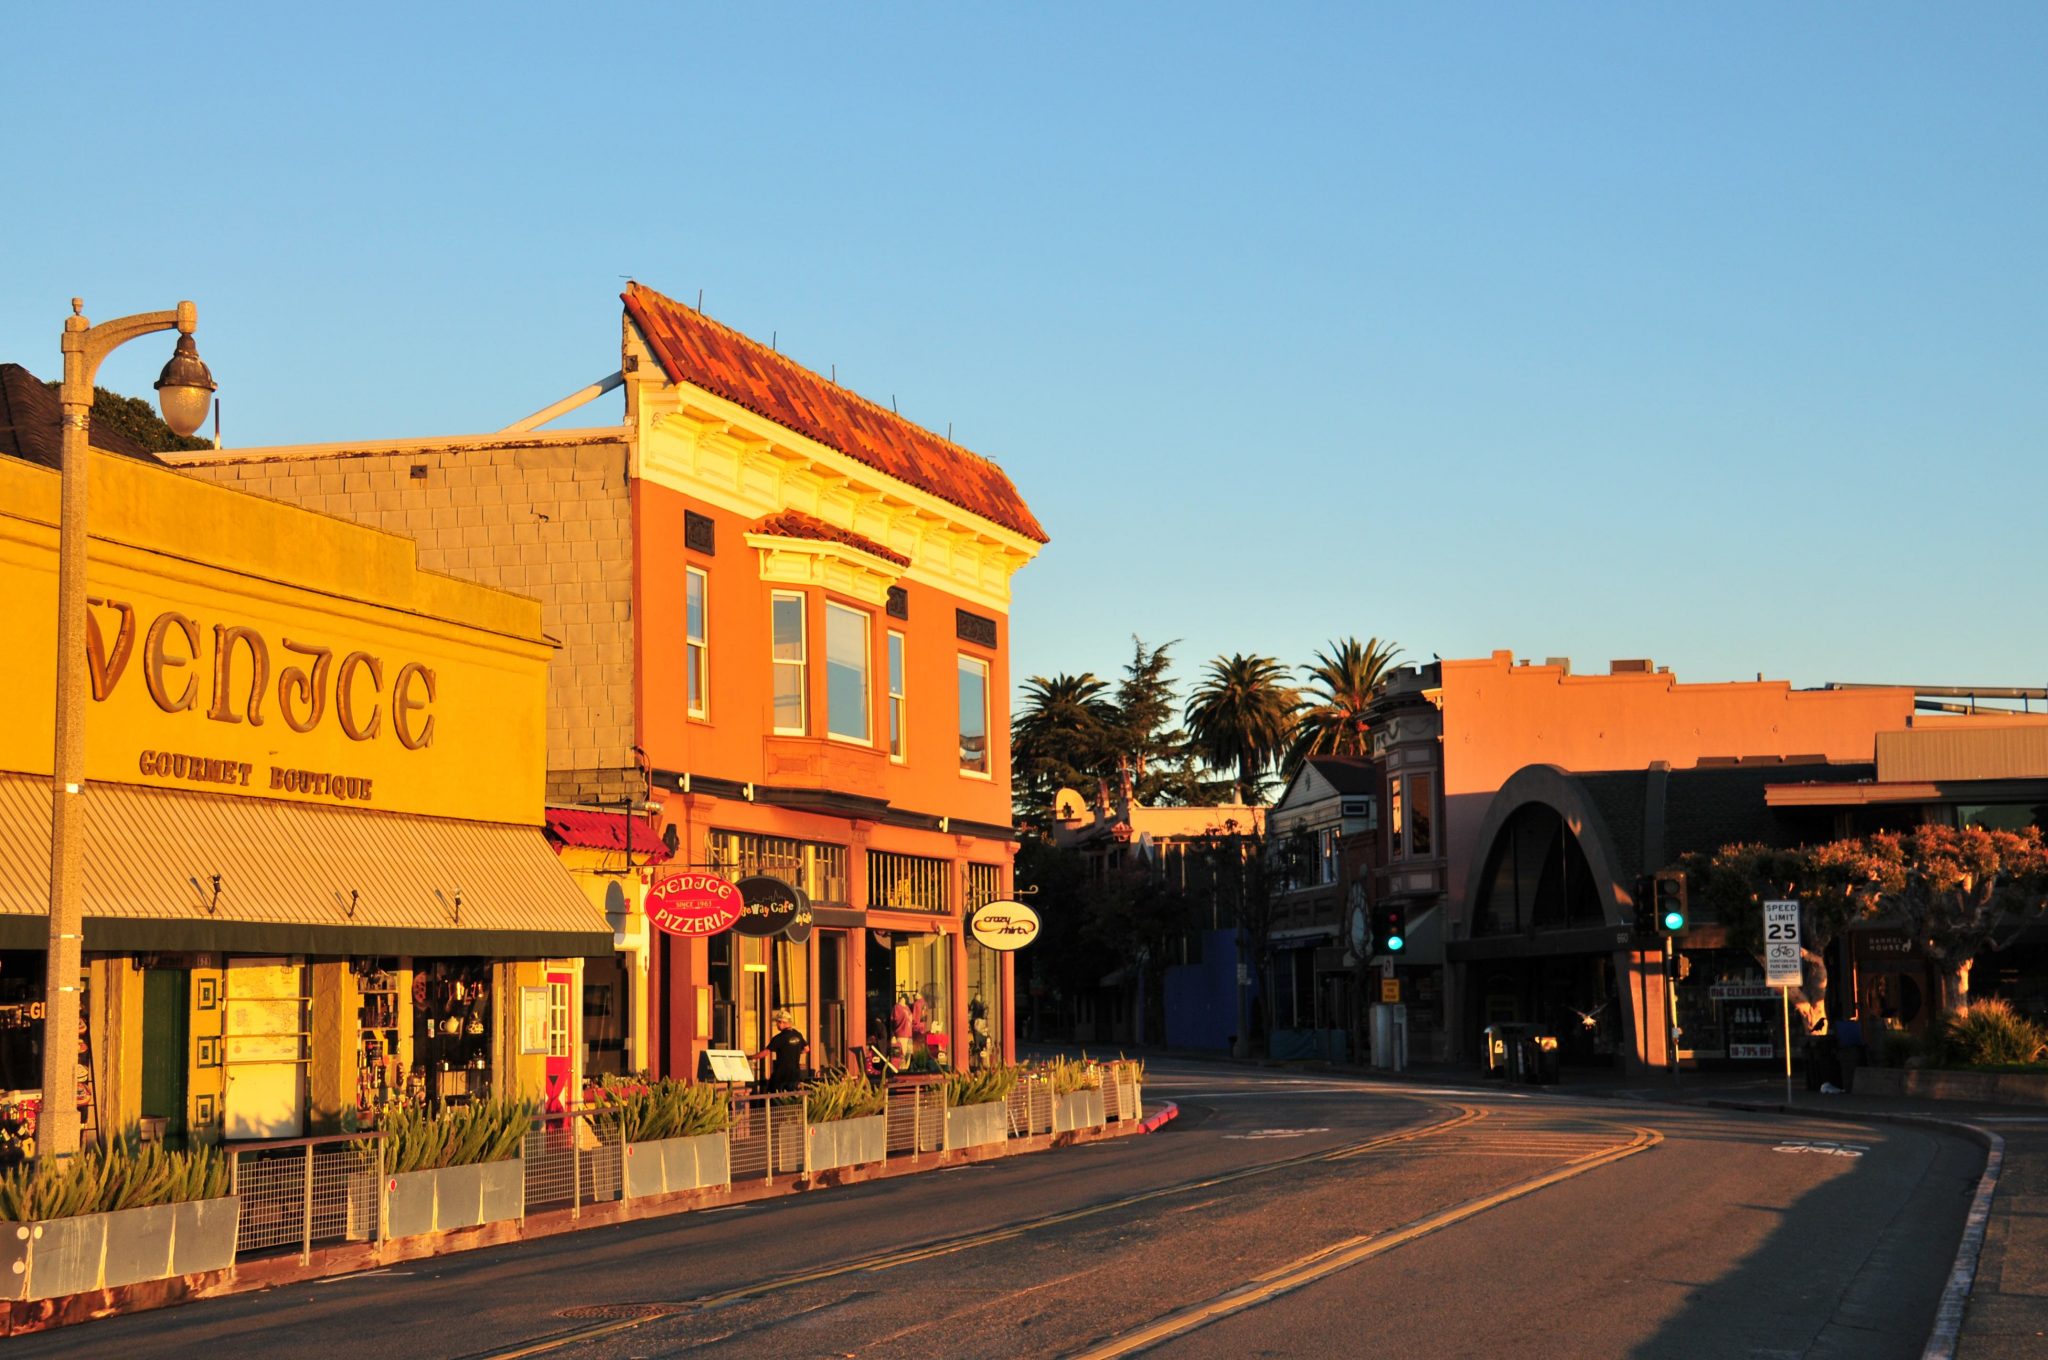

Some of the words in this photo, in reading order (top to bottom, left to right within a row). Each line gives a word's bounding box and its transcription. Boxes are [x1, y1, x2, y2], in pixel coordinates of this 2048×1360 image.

[139, 749, 253, 787] GOURMET
[270, 766, 373, 801] BOUTIQUE
[653, 876, 732, 900] VENICE
[1766, 904, 1797, 912] SPEED
[654, 908, 734, 933] PIZZERIA
[984, 916, 1011, 925] crazy
[1768, 924, 1797, 940] 25
